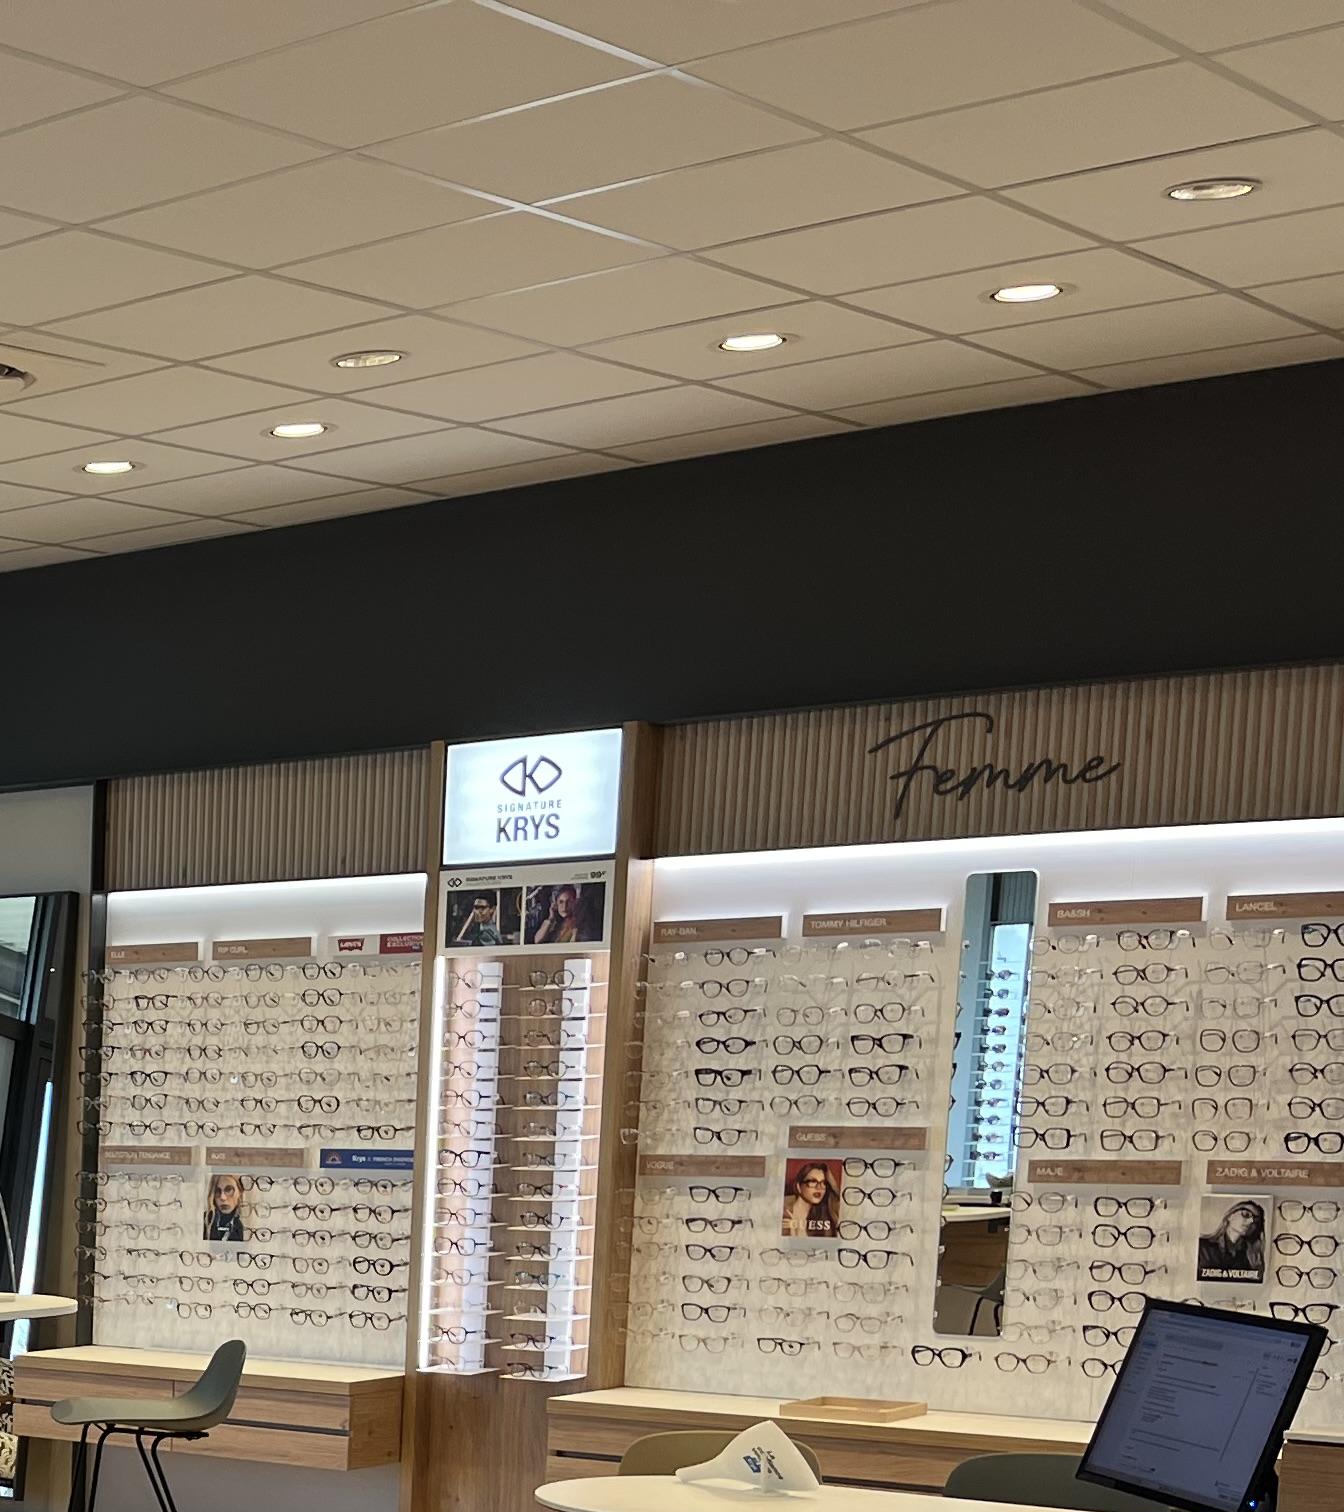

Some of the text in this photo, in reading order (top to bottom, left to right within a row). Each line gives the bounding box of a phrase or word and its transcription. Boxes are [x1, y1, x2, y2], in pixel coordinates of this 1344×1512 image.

[868, 712, 1122, 820] Femme
[497, 800, 562, 813] SIGNATURE
[496, 813, 561, 843] KRYS
[1236, 902, 1278, 912] LANCEL
[812, 918, 886, 929] TOMMY HILFIGER
[796, 1133, 827, 1142] GUESS
[1036, 1166, 1063, 1176] MAJE
[1216, 1167, 1248, 1177] ZADIG
[1261, 1168, 1310, 1179] VOLTAIRE
